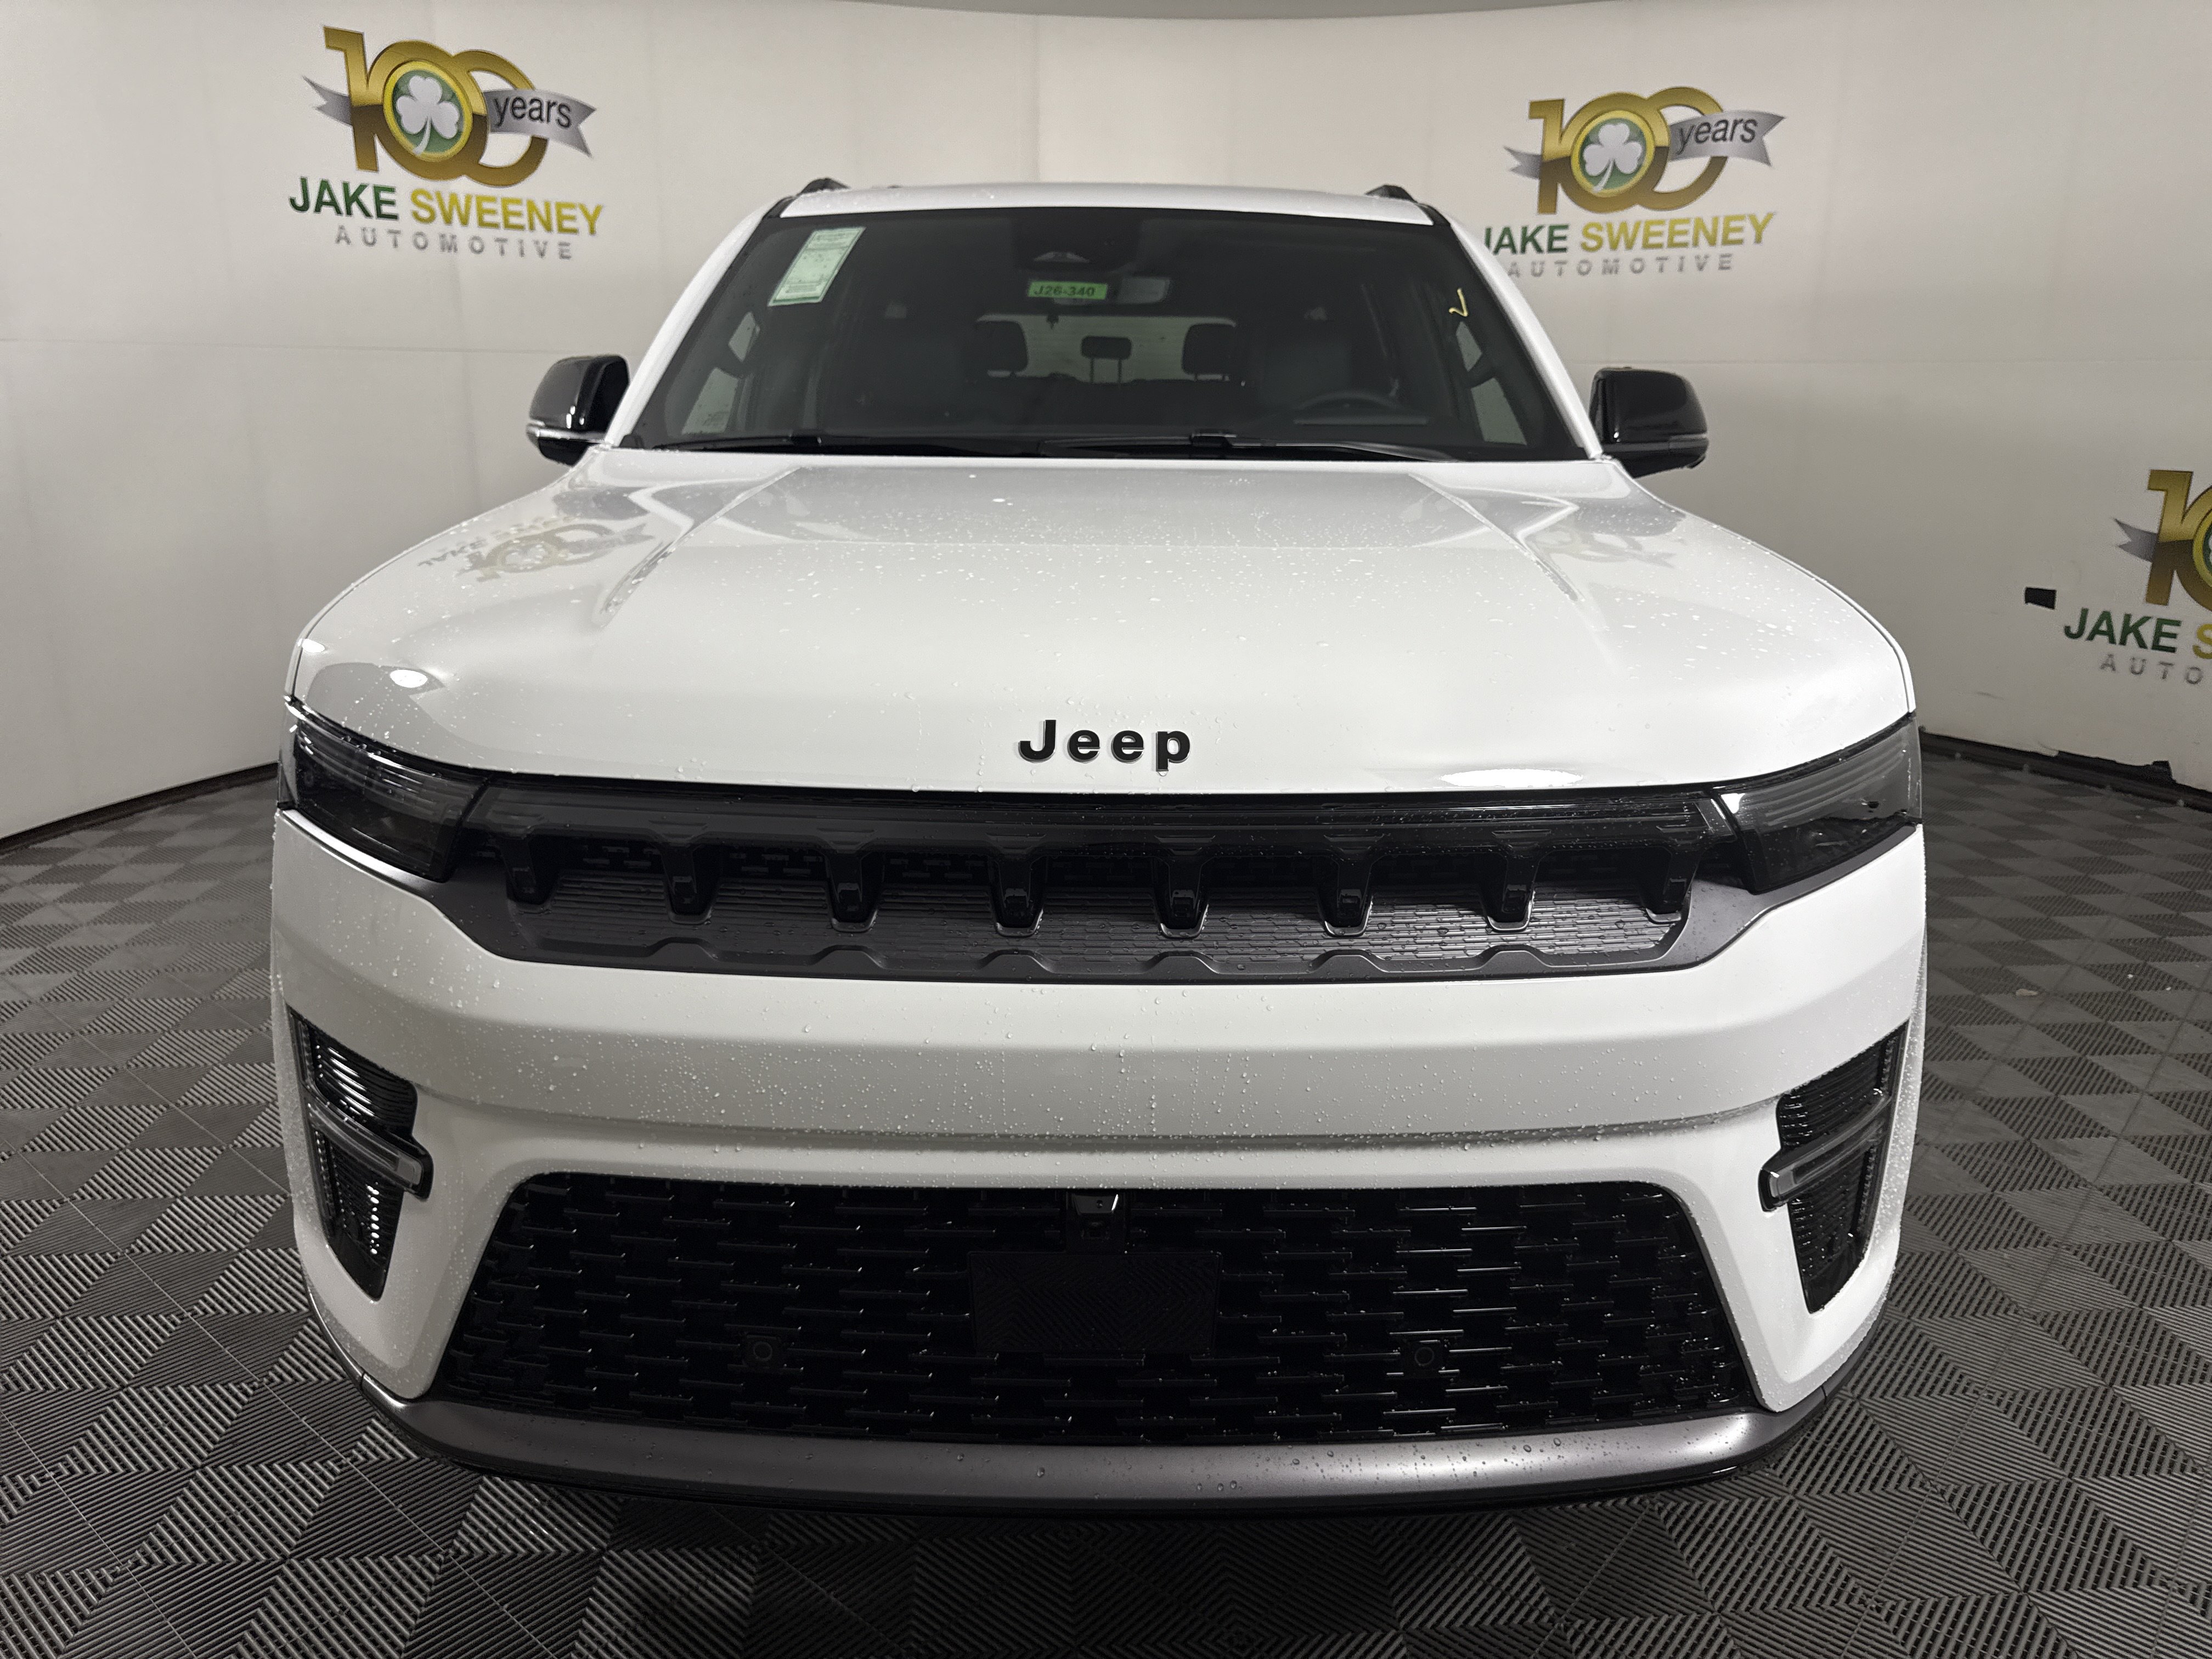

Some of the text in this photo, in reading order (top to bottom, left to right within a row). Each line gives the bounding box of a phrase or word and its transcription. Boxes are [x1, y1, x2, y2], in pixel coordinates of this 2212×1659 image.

[323, 25, 572, 188] 100 years
[1528, 86, 1758, 215] 100 years
[288, 177, 604, 236] JAKE SWEENEY
[335, 225, 572, 259] AUTOMOTIVE
[1580, 212, 1776, 253] SWEENEY
[1508, 253, 1733, 278] AUTOMOTIVE
[1034, 284, 1096, 297] J26-340
[2064, 607, 2182, 653] JAKE
[1018, 719, 1190, 772] Jeep
